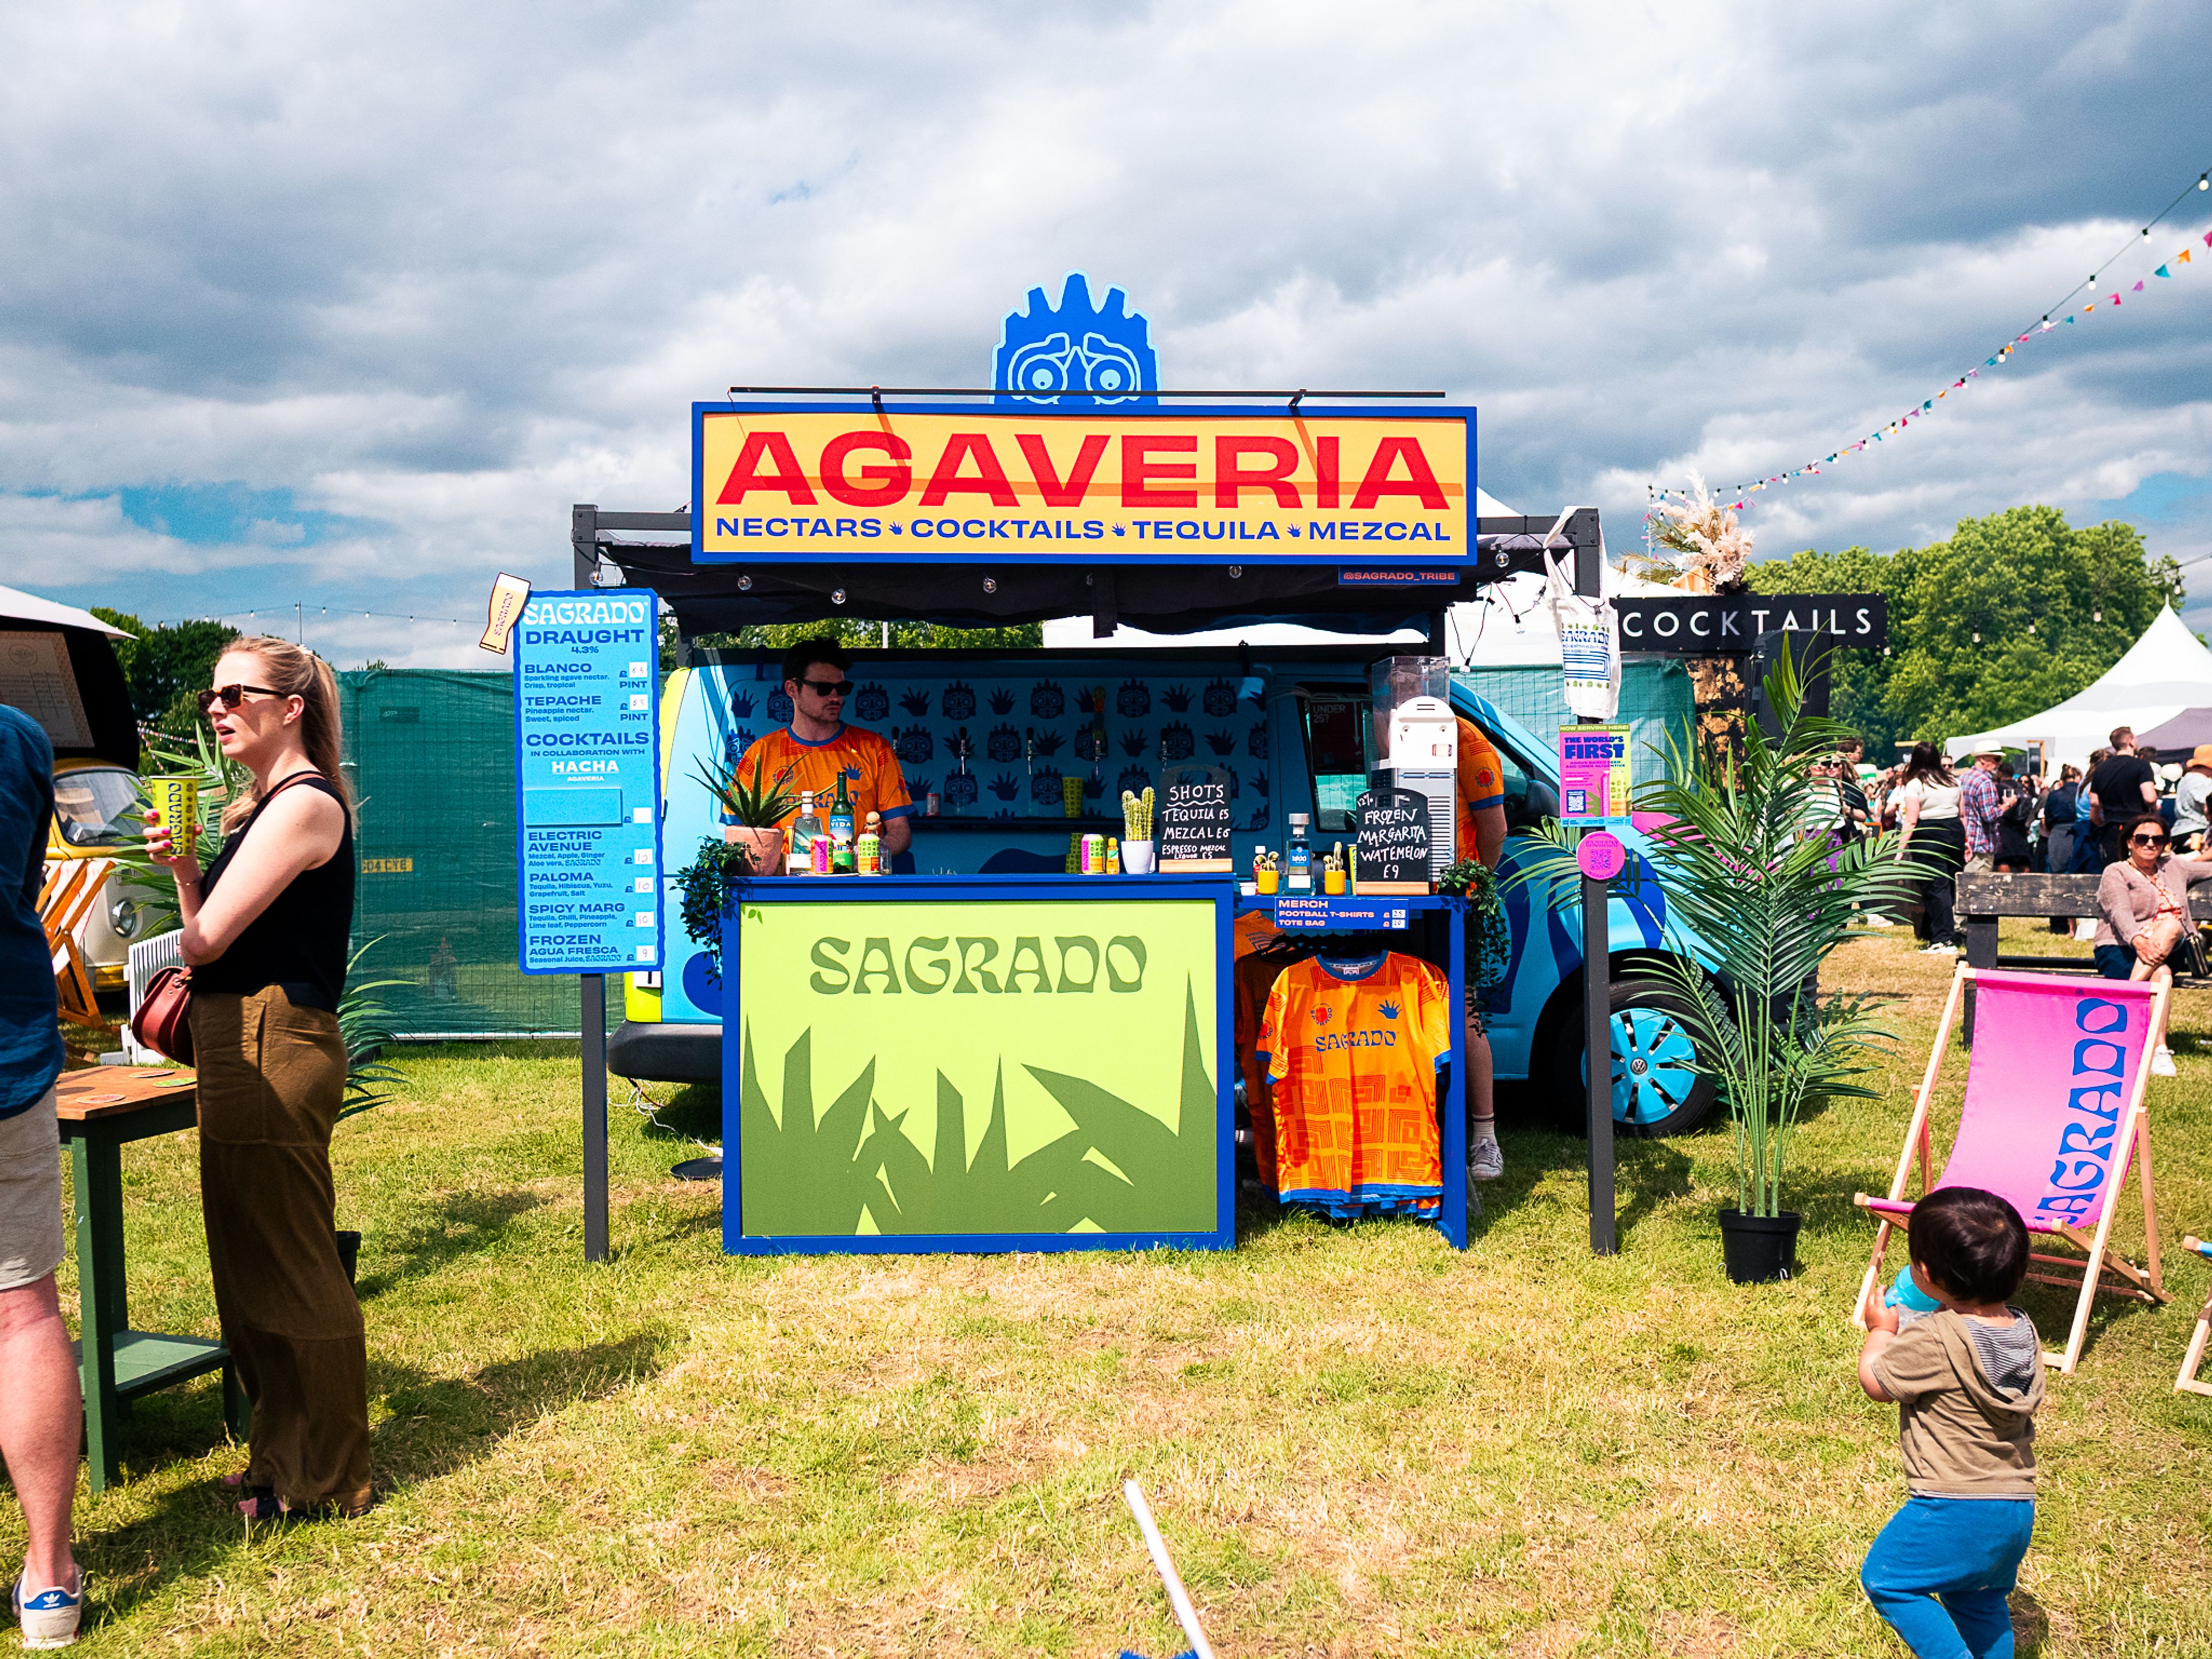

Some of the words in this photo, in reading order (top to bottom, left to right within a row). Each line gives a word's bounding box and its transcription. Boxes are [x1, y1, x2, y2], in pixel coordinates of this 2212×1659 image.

[716, 430, 1450, 510] AGAVERIA
[716, 518, 881, 539] NECTARS
[910, 519, 1104, 541] COCKTAILS
[1132, 521, 1280, 542] TEQUILA
[1310, 521, 1450, 542] MEZCAL
[1343, 571, 1455, 581] @SAGRADO_TRIBE
[522, 602, 645, 625] SAGRADO
[1622, 608, 1872, 637] COCKTAILS
[525, 630, 645, 645] DRAUGHT
[525, 663, 592, 674] BLANCO
[525, 695, 601, 706] TEPACHE
[1313, 704, 1346, 714] UNDER
[1313, 714, 1329, 724] 25?
[526, 732, 649, 747] COCKTAILS
[1565, 744, 1624, 759] FIRST
[551, 760, 619, 772] HACHA
[1169, 784, 1224, 801] SHOTS
[1357, 793, 1374, 807] 12%
[168, 783, 183, 855] SAGRADO
[1162, 808, 1215, 822] TEQUILA
[1365, 808, 1418, 825] FROZEN
[528, 831, 603, 841] ELECTRIC
[1162, 826, 1214, 840] MEZCAL
[1357, 825, 1427, 847] MARGARITA
[528, 842, 592, 852] AVENUE
[1162, 844, 1198, 855] ESPRESSO
[1359, 845, 1429, 863] WATEMELON
[529, 872, 594, 882] PALOMA
[529, 904, 575, 914] SPICY
[579, 903, 626, 912] MARG
[1278, 900, 1328, 908] MERCH
[529, 934, 601, 945] FROZEN
[529, 948, 565, 956] AGUA
[568, 946, 619, 955] FRESCA
[809, 935, 1147, 994] SAGRADO
[1315, 1030, 1396, 1052] SAGRADO
